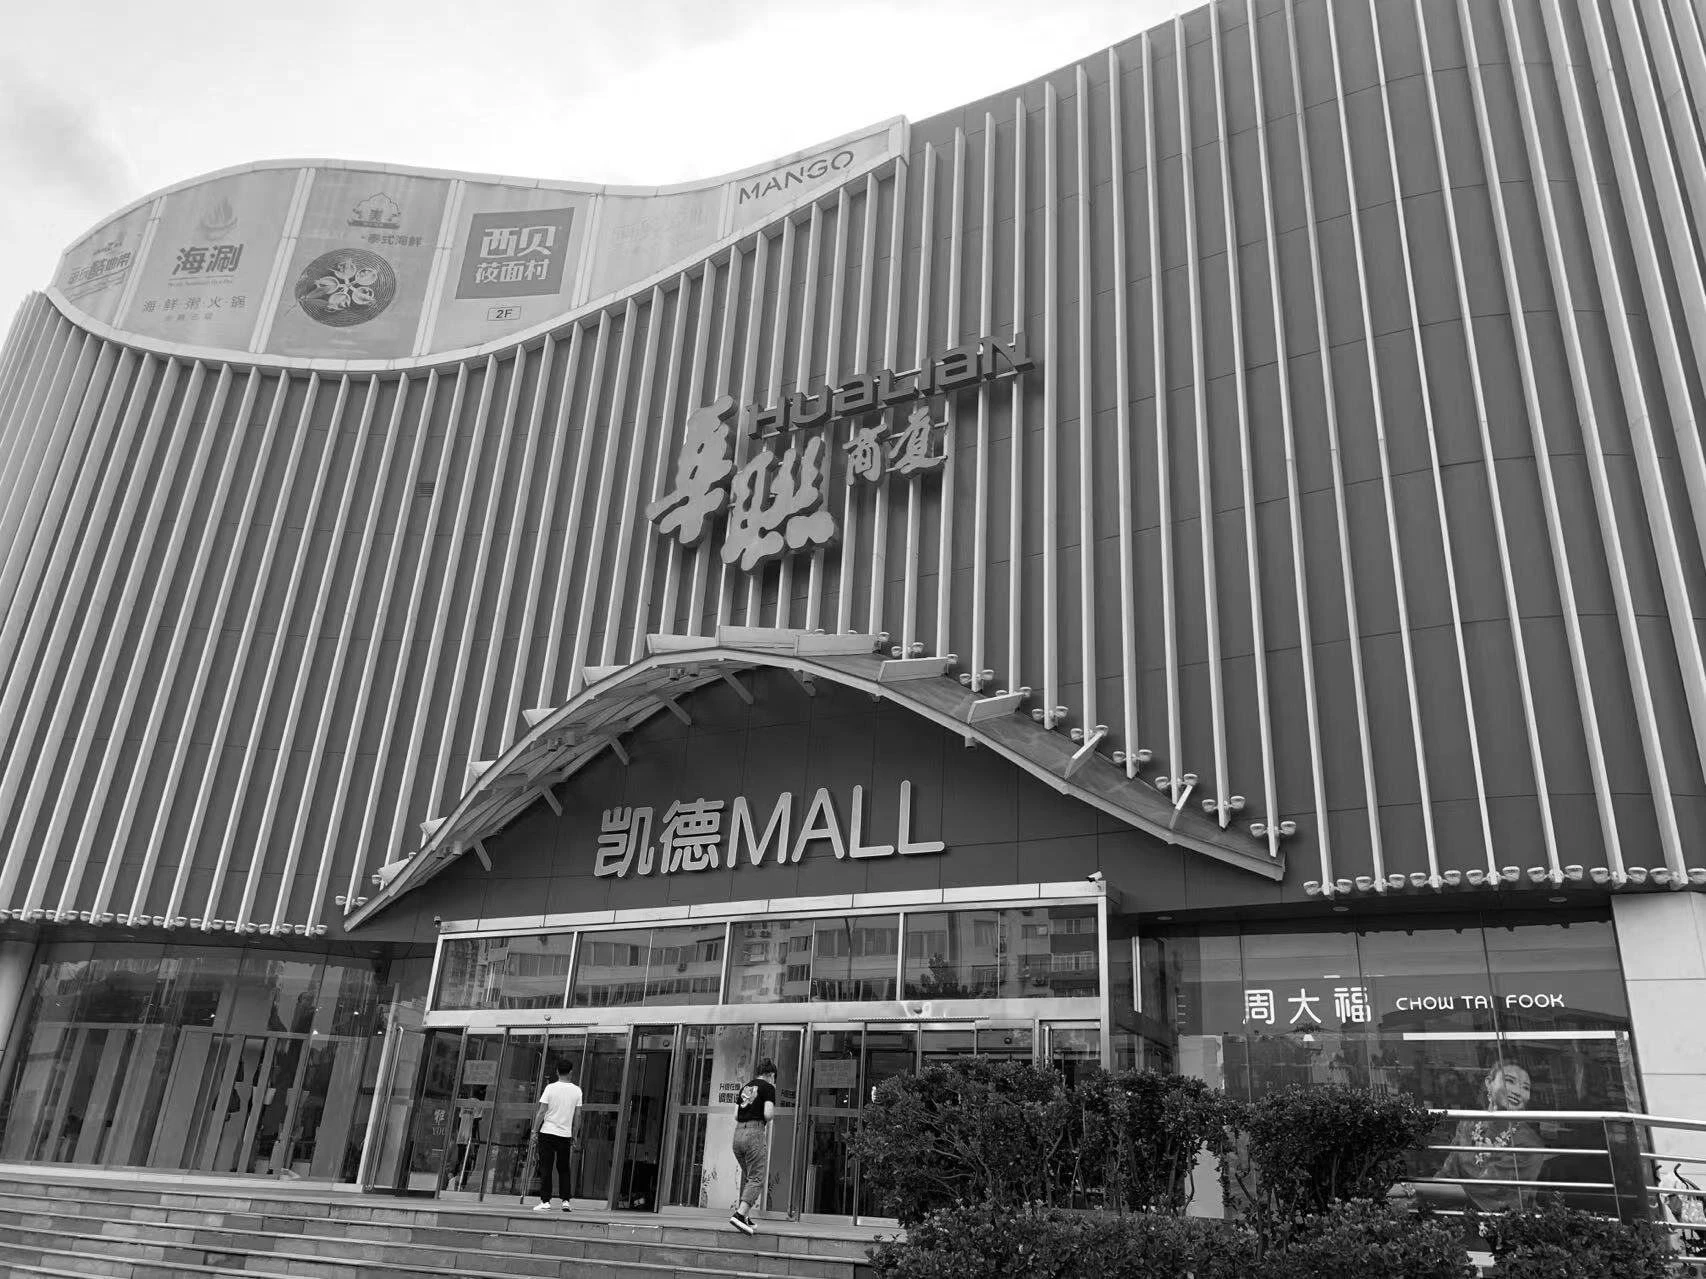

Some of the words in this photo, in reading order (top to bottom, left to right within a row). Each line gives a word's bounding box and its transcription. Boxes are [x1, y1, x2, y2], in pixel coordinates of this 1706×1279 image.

[739, 151, 854, 204] MANGO
[480, 226, 556, 258] 西贝
[172, 243, 244, 275] 海涮
[475, 259, 550, 283] 莜面村
[496, 309, 512, 318] 2F
[1243, 987, 1371, 1024] 周大福
[1396, 995, 1454, 1010] CHOW
[1461, 995, 1494, 1009] TAI
[1506, 994, 1565, 1008] FOOK
